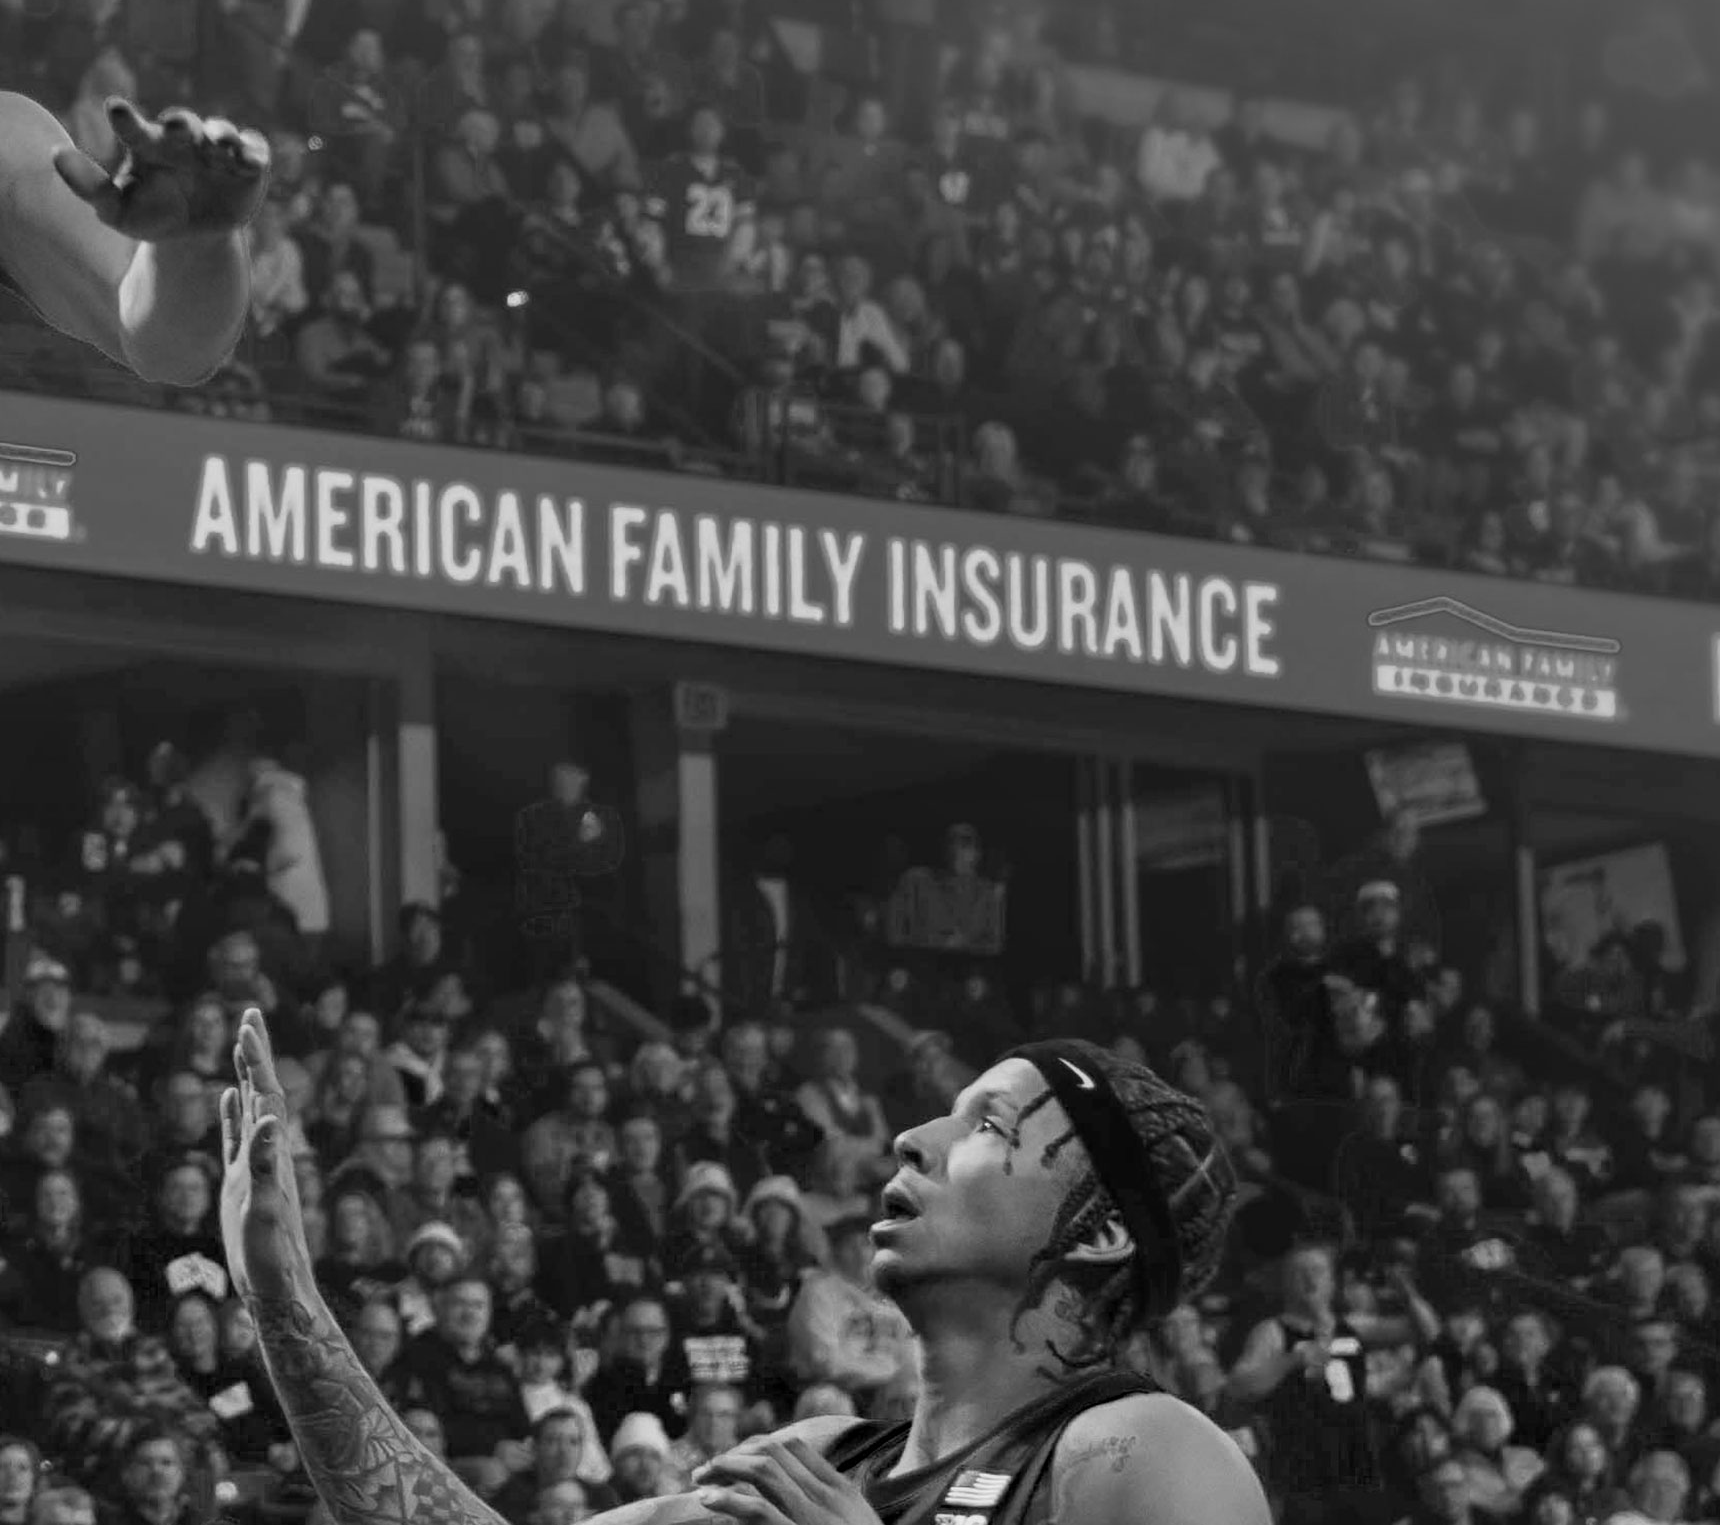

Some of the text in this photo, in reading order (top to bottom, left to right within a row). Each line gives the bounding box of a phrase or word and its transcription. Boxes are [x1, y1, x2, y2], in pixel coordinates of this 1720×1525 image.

[188, 454, 1283, 679] AMERICAN FAMILY INSURANCE
